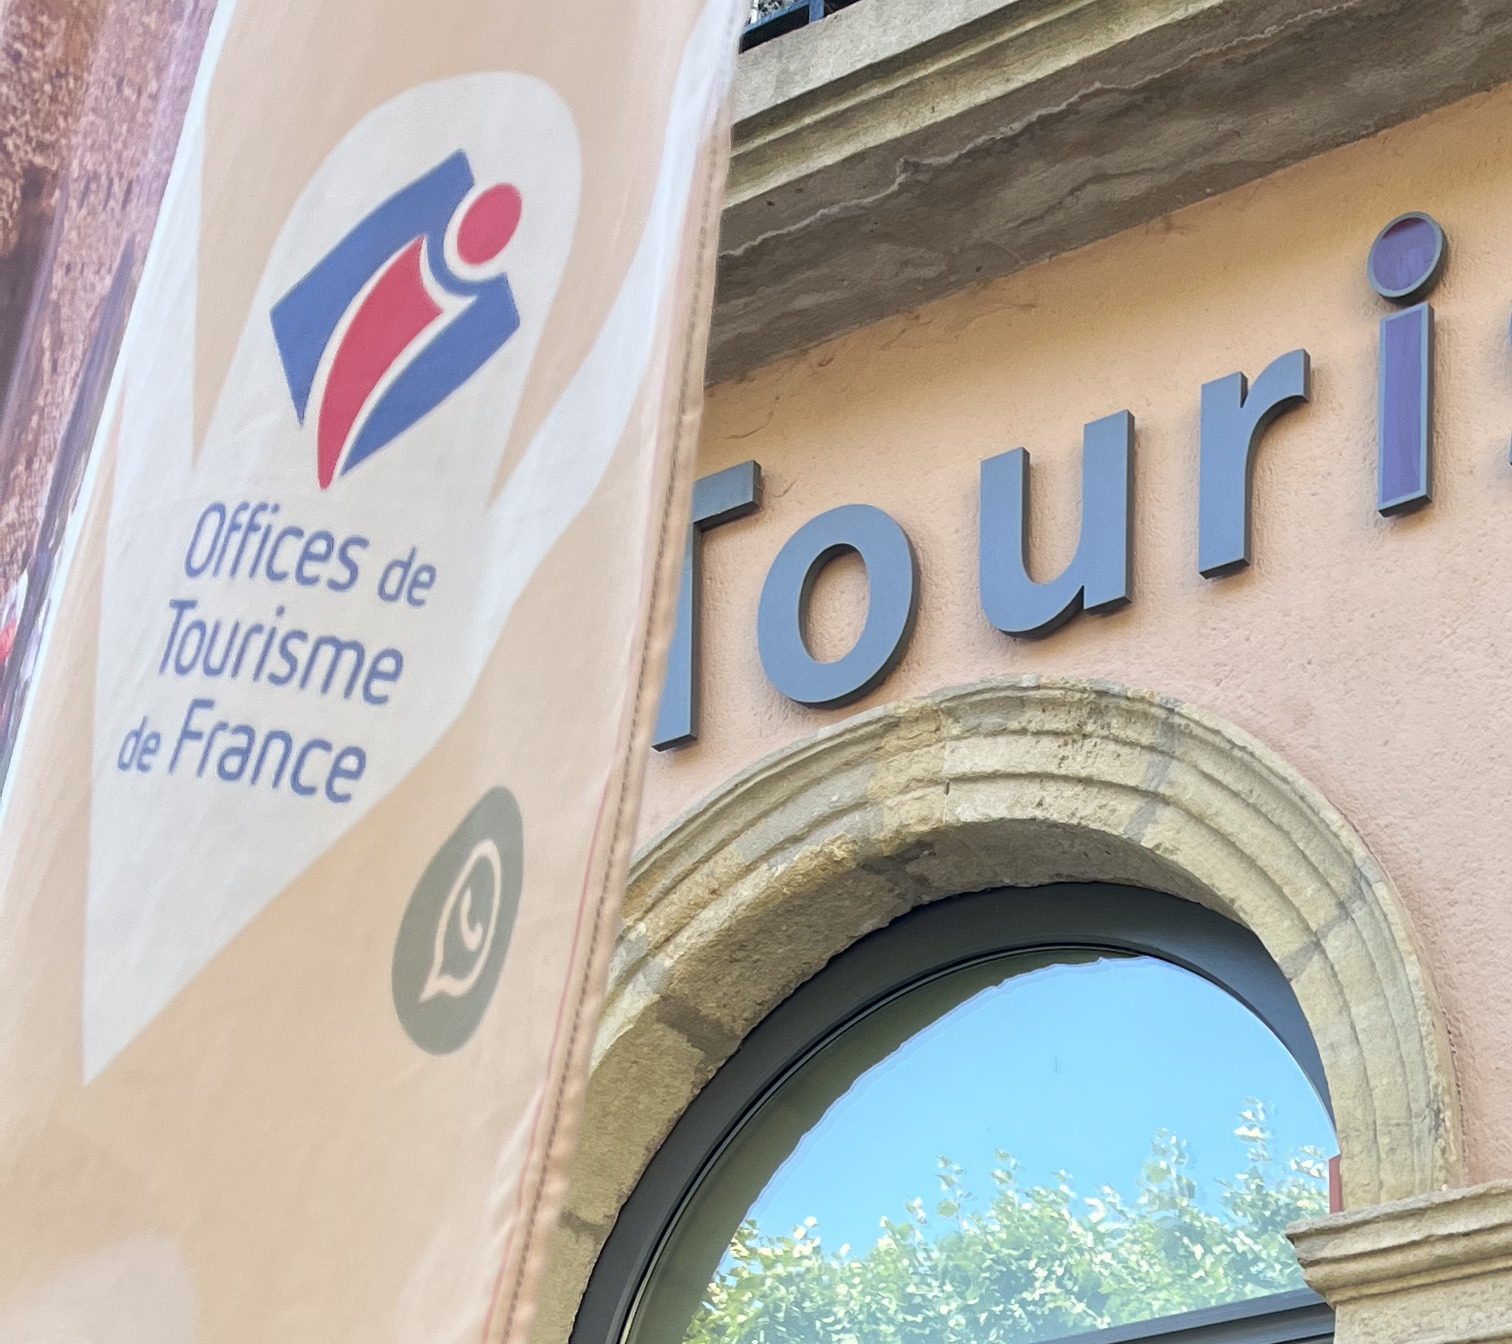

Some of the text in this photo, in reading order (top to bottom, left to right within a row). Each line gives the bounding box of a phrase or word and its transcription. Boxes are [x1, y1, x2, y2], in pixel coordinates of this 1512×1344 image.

[184, 502, 437, 607] Offices de
[157, 598, 404, 706] Tourisme
[117, 698, 367, 803] de France
